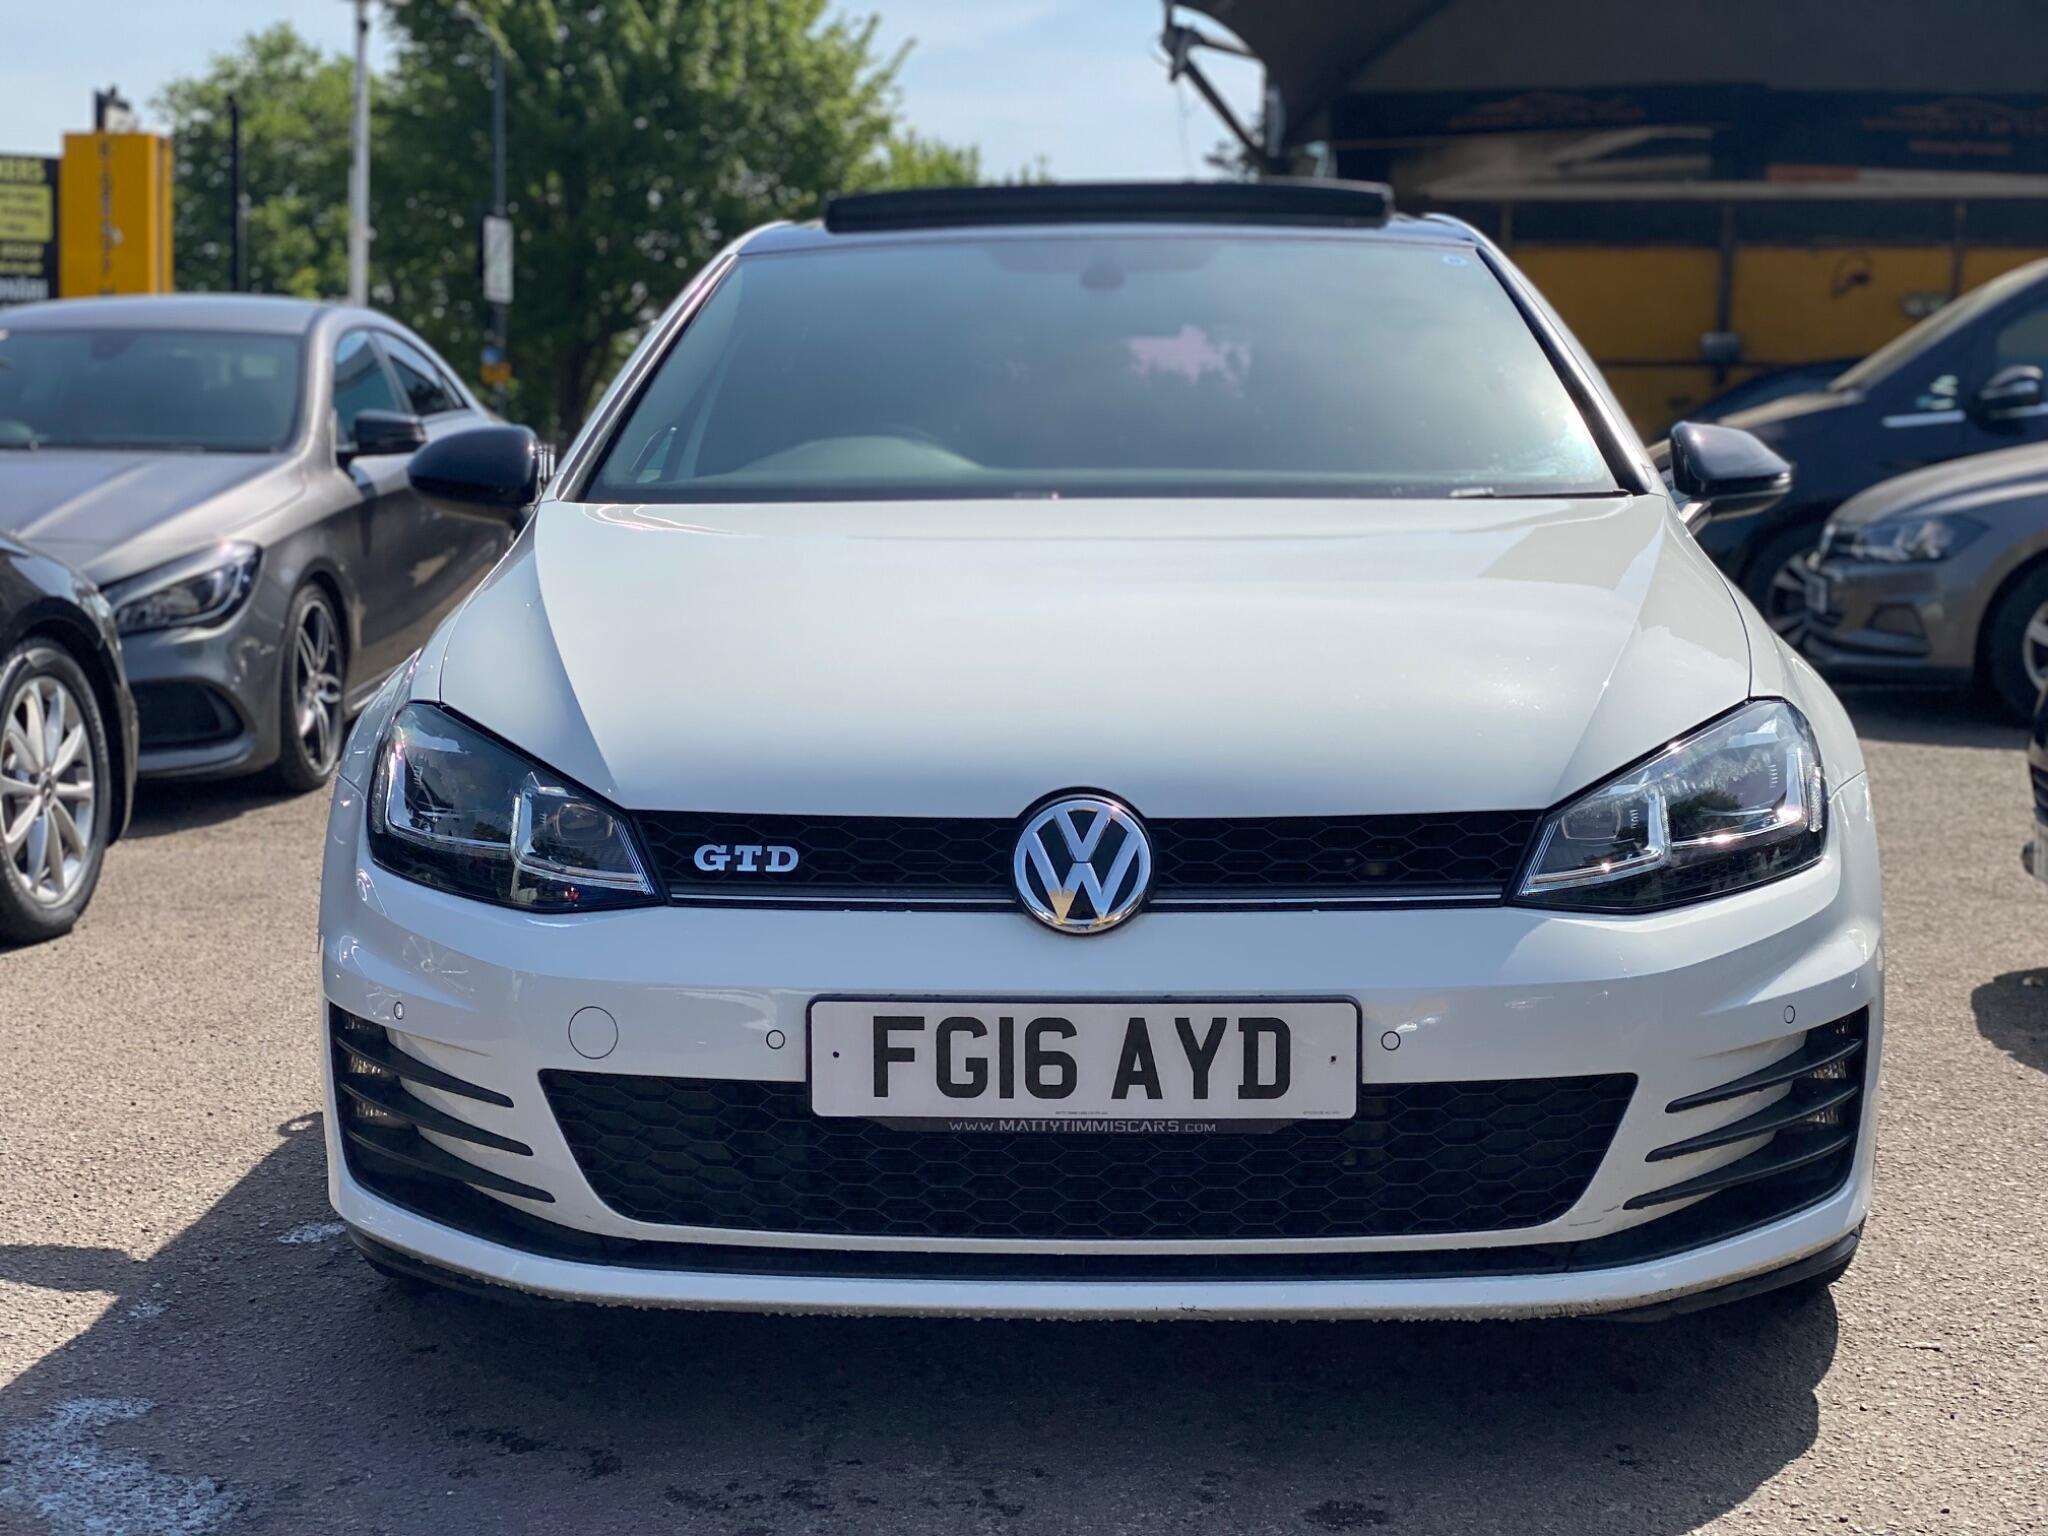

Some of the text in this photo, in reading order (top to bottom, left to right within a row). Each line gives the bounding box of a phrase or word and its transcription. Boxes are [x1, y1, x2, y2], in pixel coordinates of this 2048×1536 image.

[694, 844, 799, 872] GTD
[1016, 802, 1150, 926] VW
[873, 1016, 1290, 1100] FG16 AYD
